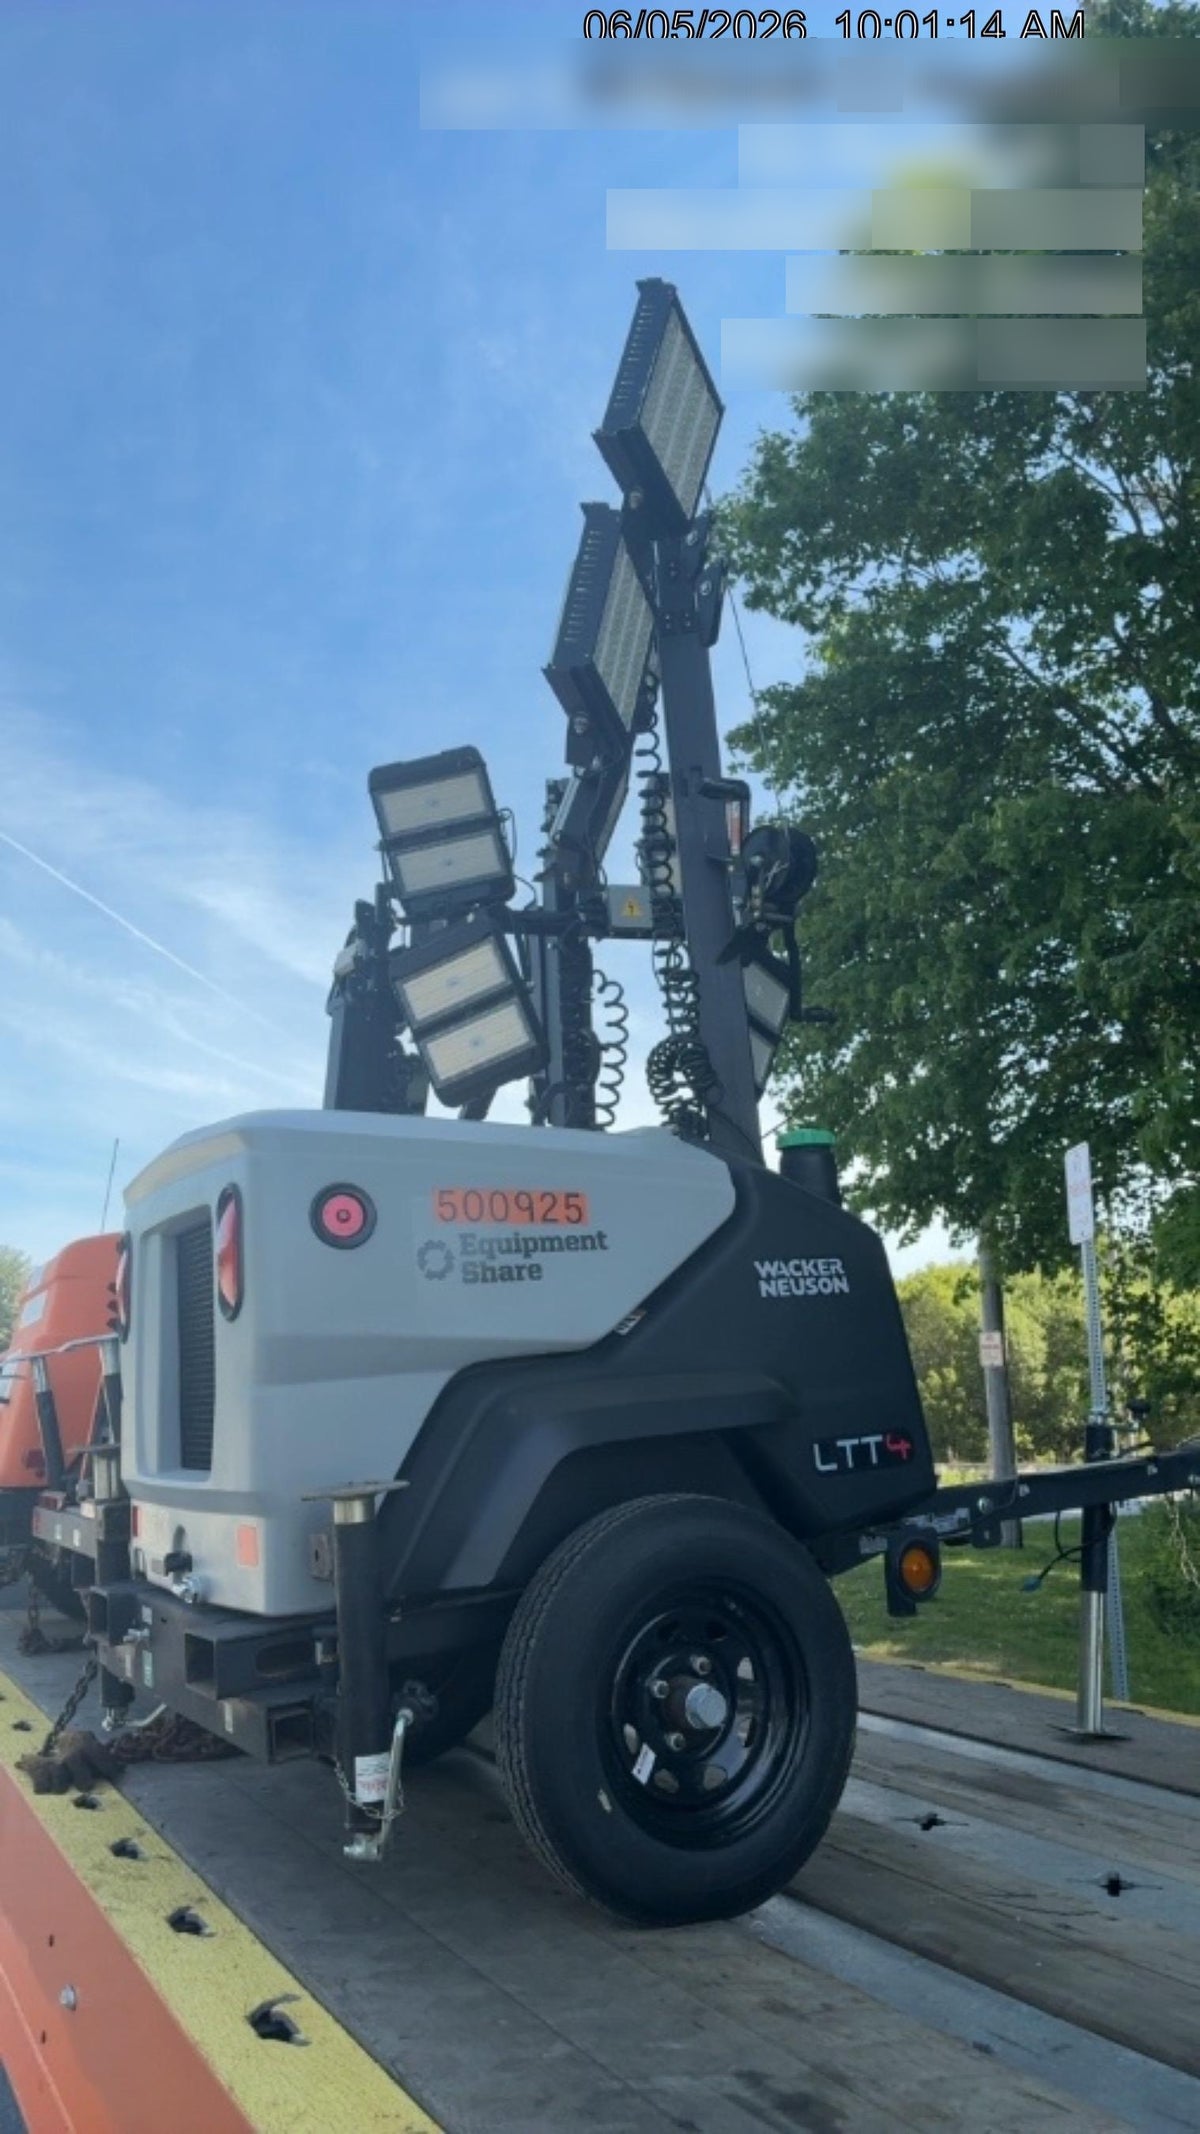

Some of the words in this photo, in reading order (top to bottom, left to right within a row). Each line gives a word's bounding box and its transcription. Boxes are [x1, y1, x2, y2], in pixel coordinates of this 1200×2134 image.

[438, 1189, 583, 1225] 500925
[459, 1230, 609, 1260] Equipment
[462, 1261, 543, 1285] Share
[753, 1258, 845, 1279] WACKER
[759, 1275, 850, 1298] NEUSON
[813, 1433, 911, 1471] LTT4
